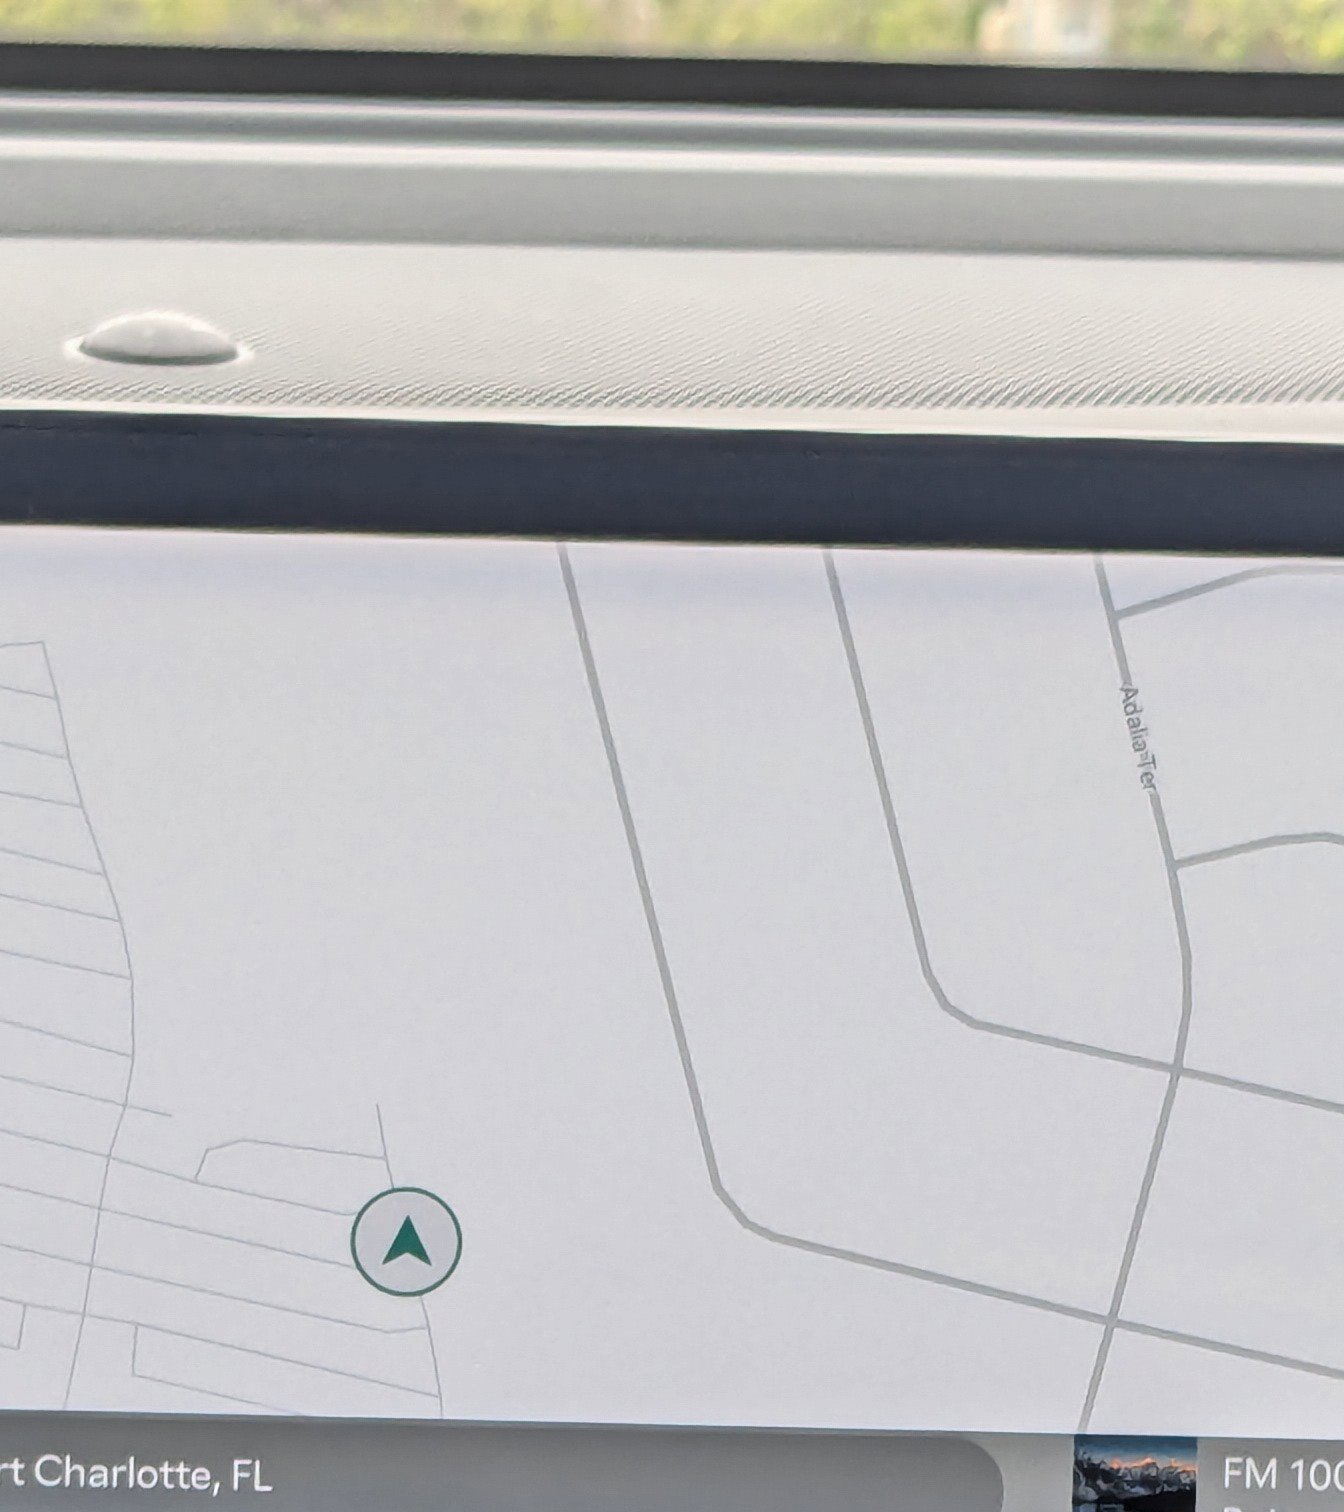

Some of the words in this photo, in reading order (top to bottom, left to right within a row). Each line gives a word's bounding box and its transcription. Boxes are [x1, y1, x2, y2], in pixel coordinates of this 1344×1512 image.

[1118, 686, 1150, 754] Adalia
[1136, 752, 1157, 790] Ter
[34, 1454, 220, 1497] Charlotte,
[233, 1459, 273, 1492] FL
[1224, 1457, 1277, 1489] FM
